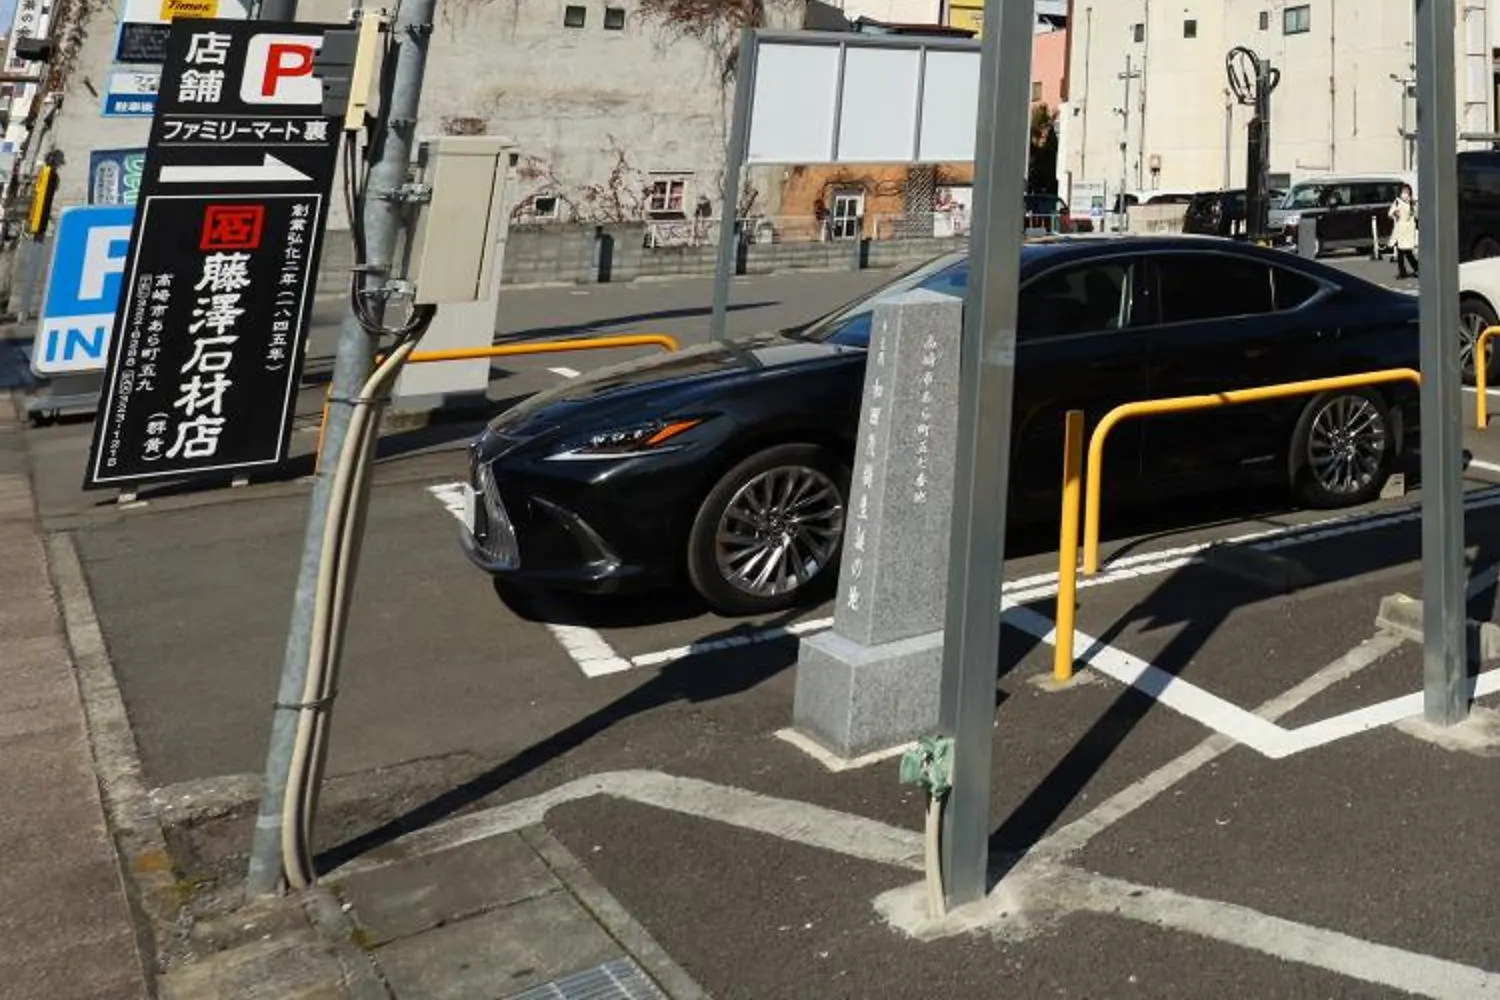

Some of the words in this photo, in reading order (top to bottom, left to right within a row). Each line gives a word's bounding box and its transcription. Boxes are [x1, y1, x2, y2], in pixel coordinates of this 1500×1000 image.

[178, 31, 232, 103] 店舗
[261, 43, 314, 97] P
[45, 327, 105, 362] IN
[165, 251, 251, 459] 藤澤石材店
